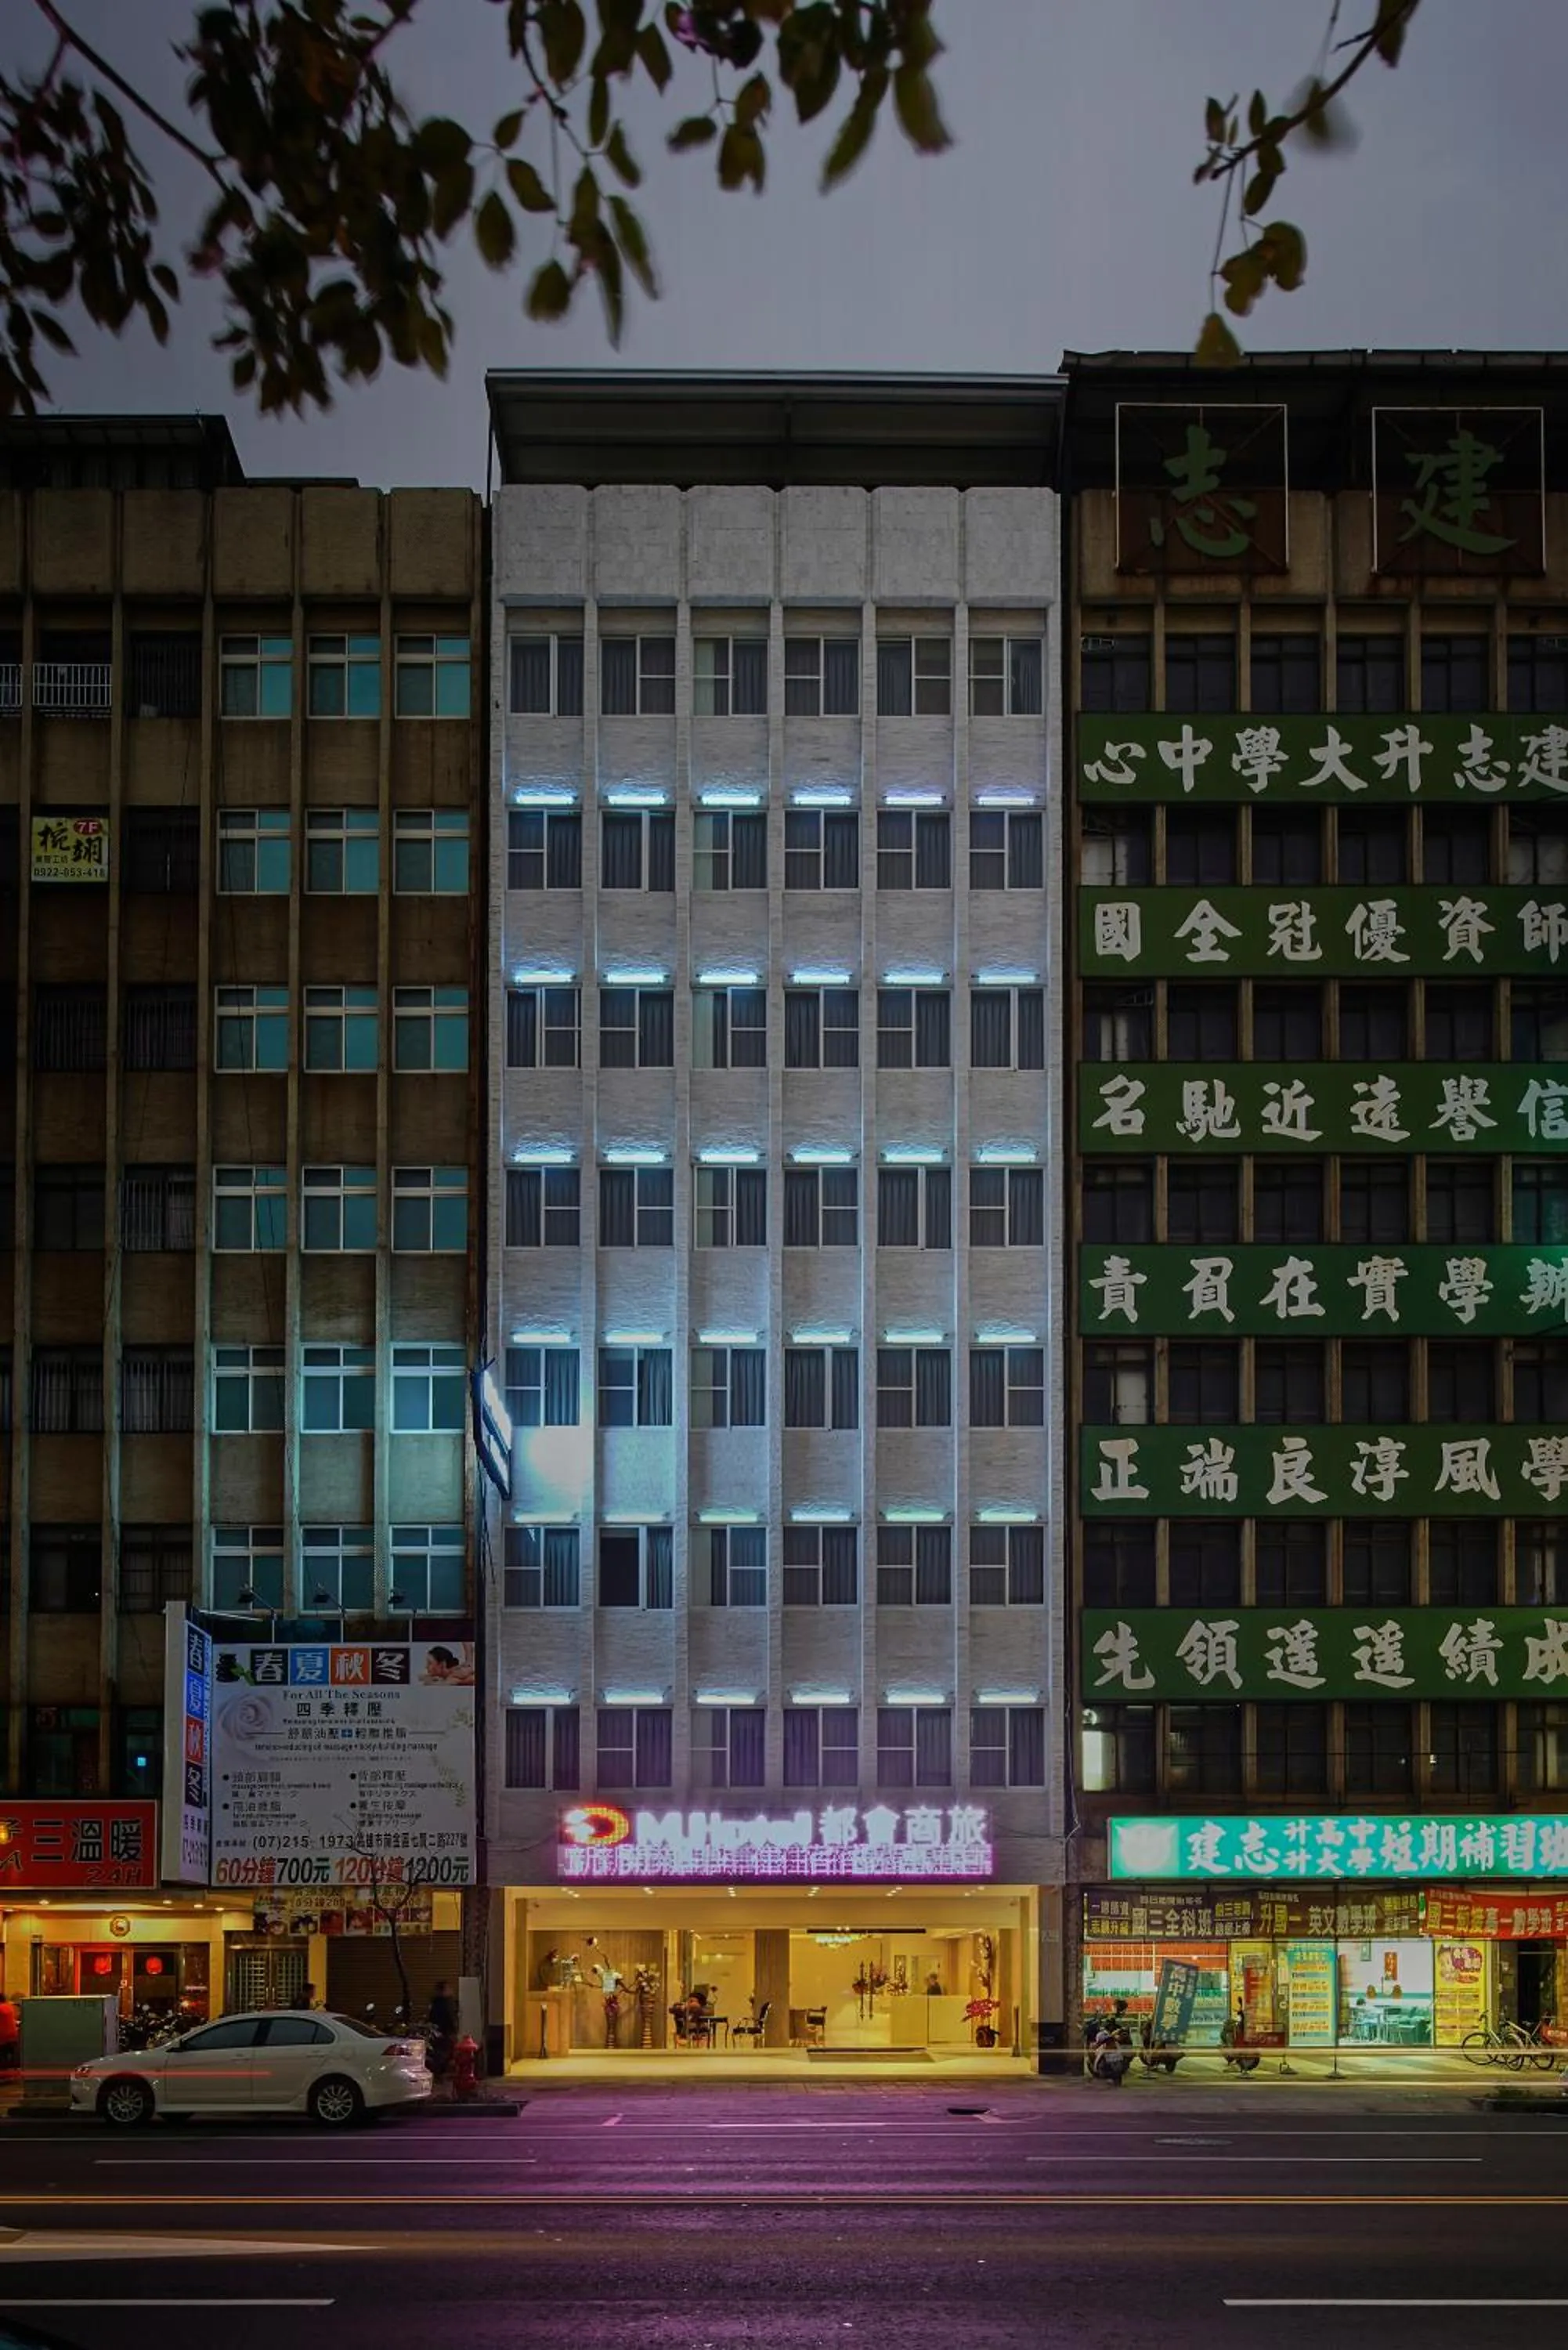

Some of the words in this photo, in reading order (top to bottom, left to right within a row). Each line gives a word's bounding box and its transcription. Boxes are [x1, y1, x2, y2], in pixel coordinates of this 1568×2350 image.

[254, 1651, 405, 1683] 春夏秋冬
[283, 1690, 302, 1700] For
[306, 1690, 322, 1699] All
[325, 1690, 348, 1699] The
[352, 1690, 400, 1699] Seasons
[818, 1804, 986, 1845] 都會商旅
[1282, 1818, 1378, 1844] 升高中
[1186, 1819, 1280, 1875] 建志
[1282, 1846, 1378, 1875] 升大學
